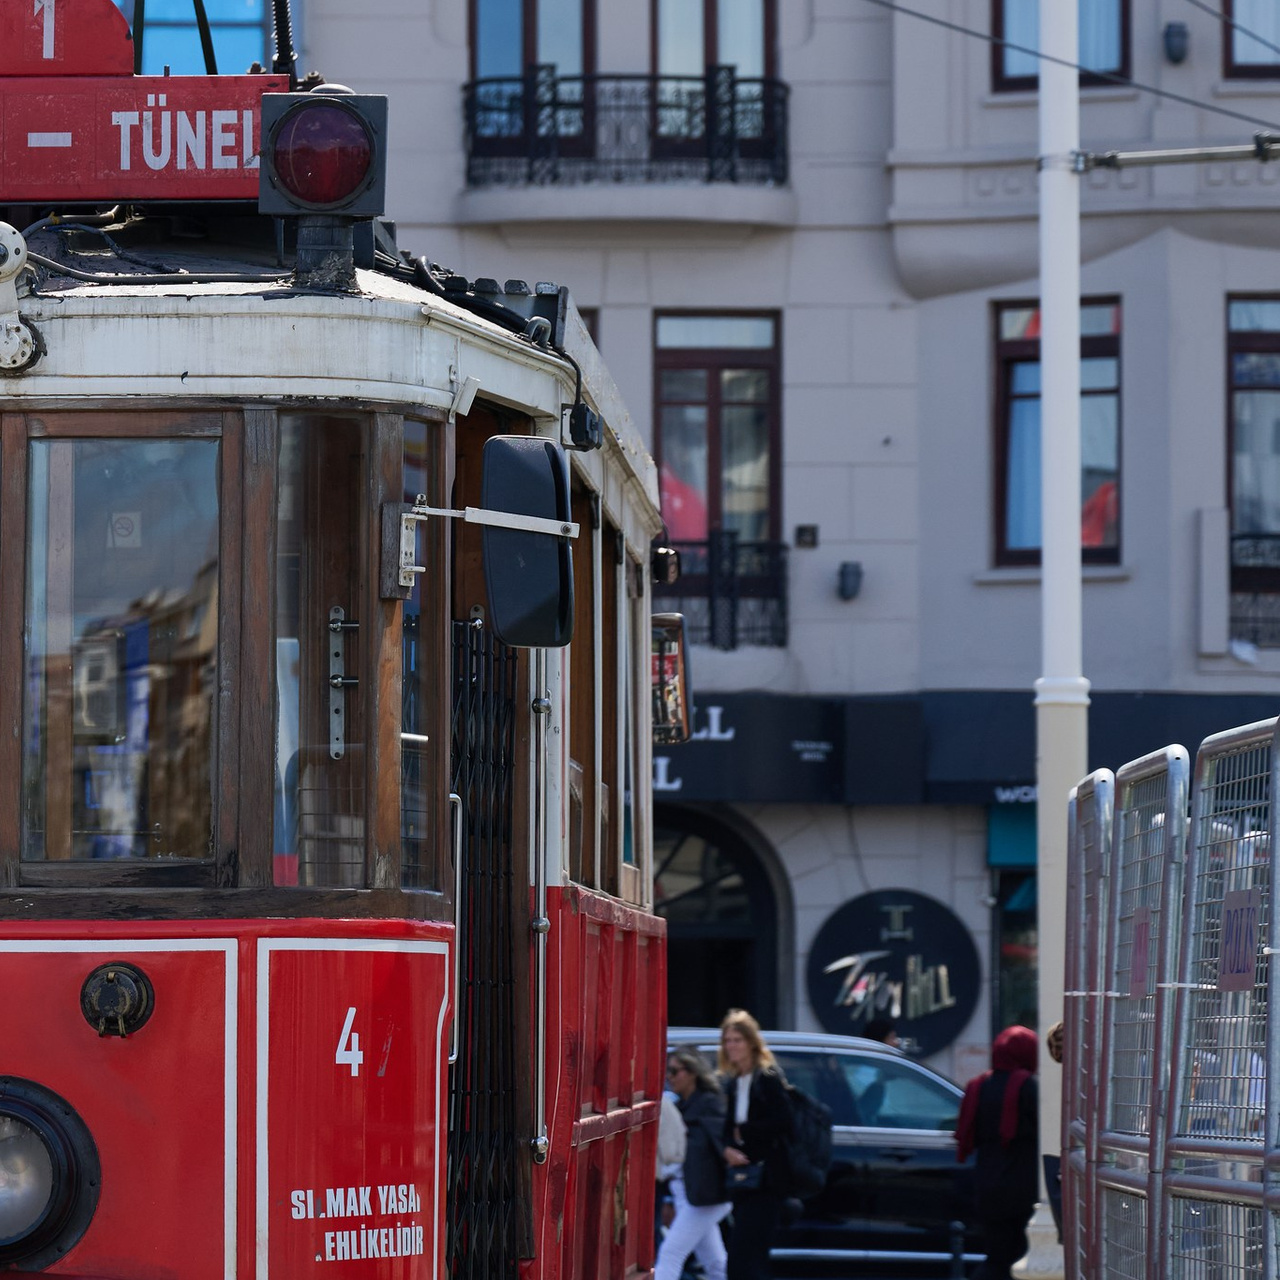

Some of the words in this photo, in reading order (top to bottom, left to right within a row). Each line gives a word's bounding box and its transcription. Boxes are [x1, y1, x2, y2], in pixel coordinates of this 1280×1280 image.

[111, 93, 261, 171] TÜNEL
[291, 1186, 373, 1220] SIMAK
[377, 1183, 421, 1216] YASA
[315, 1220, 424, 1262] EHLİKELİDİR
